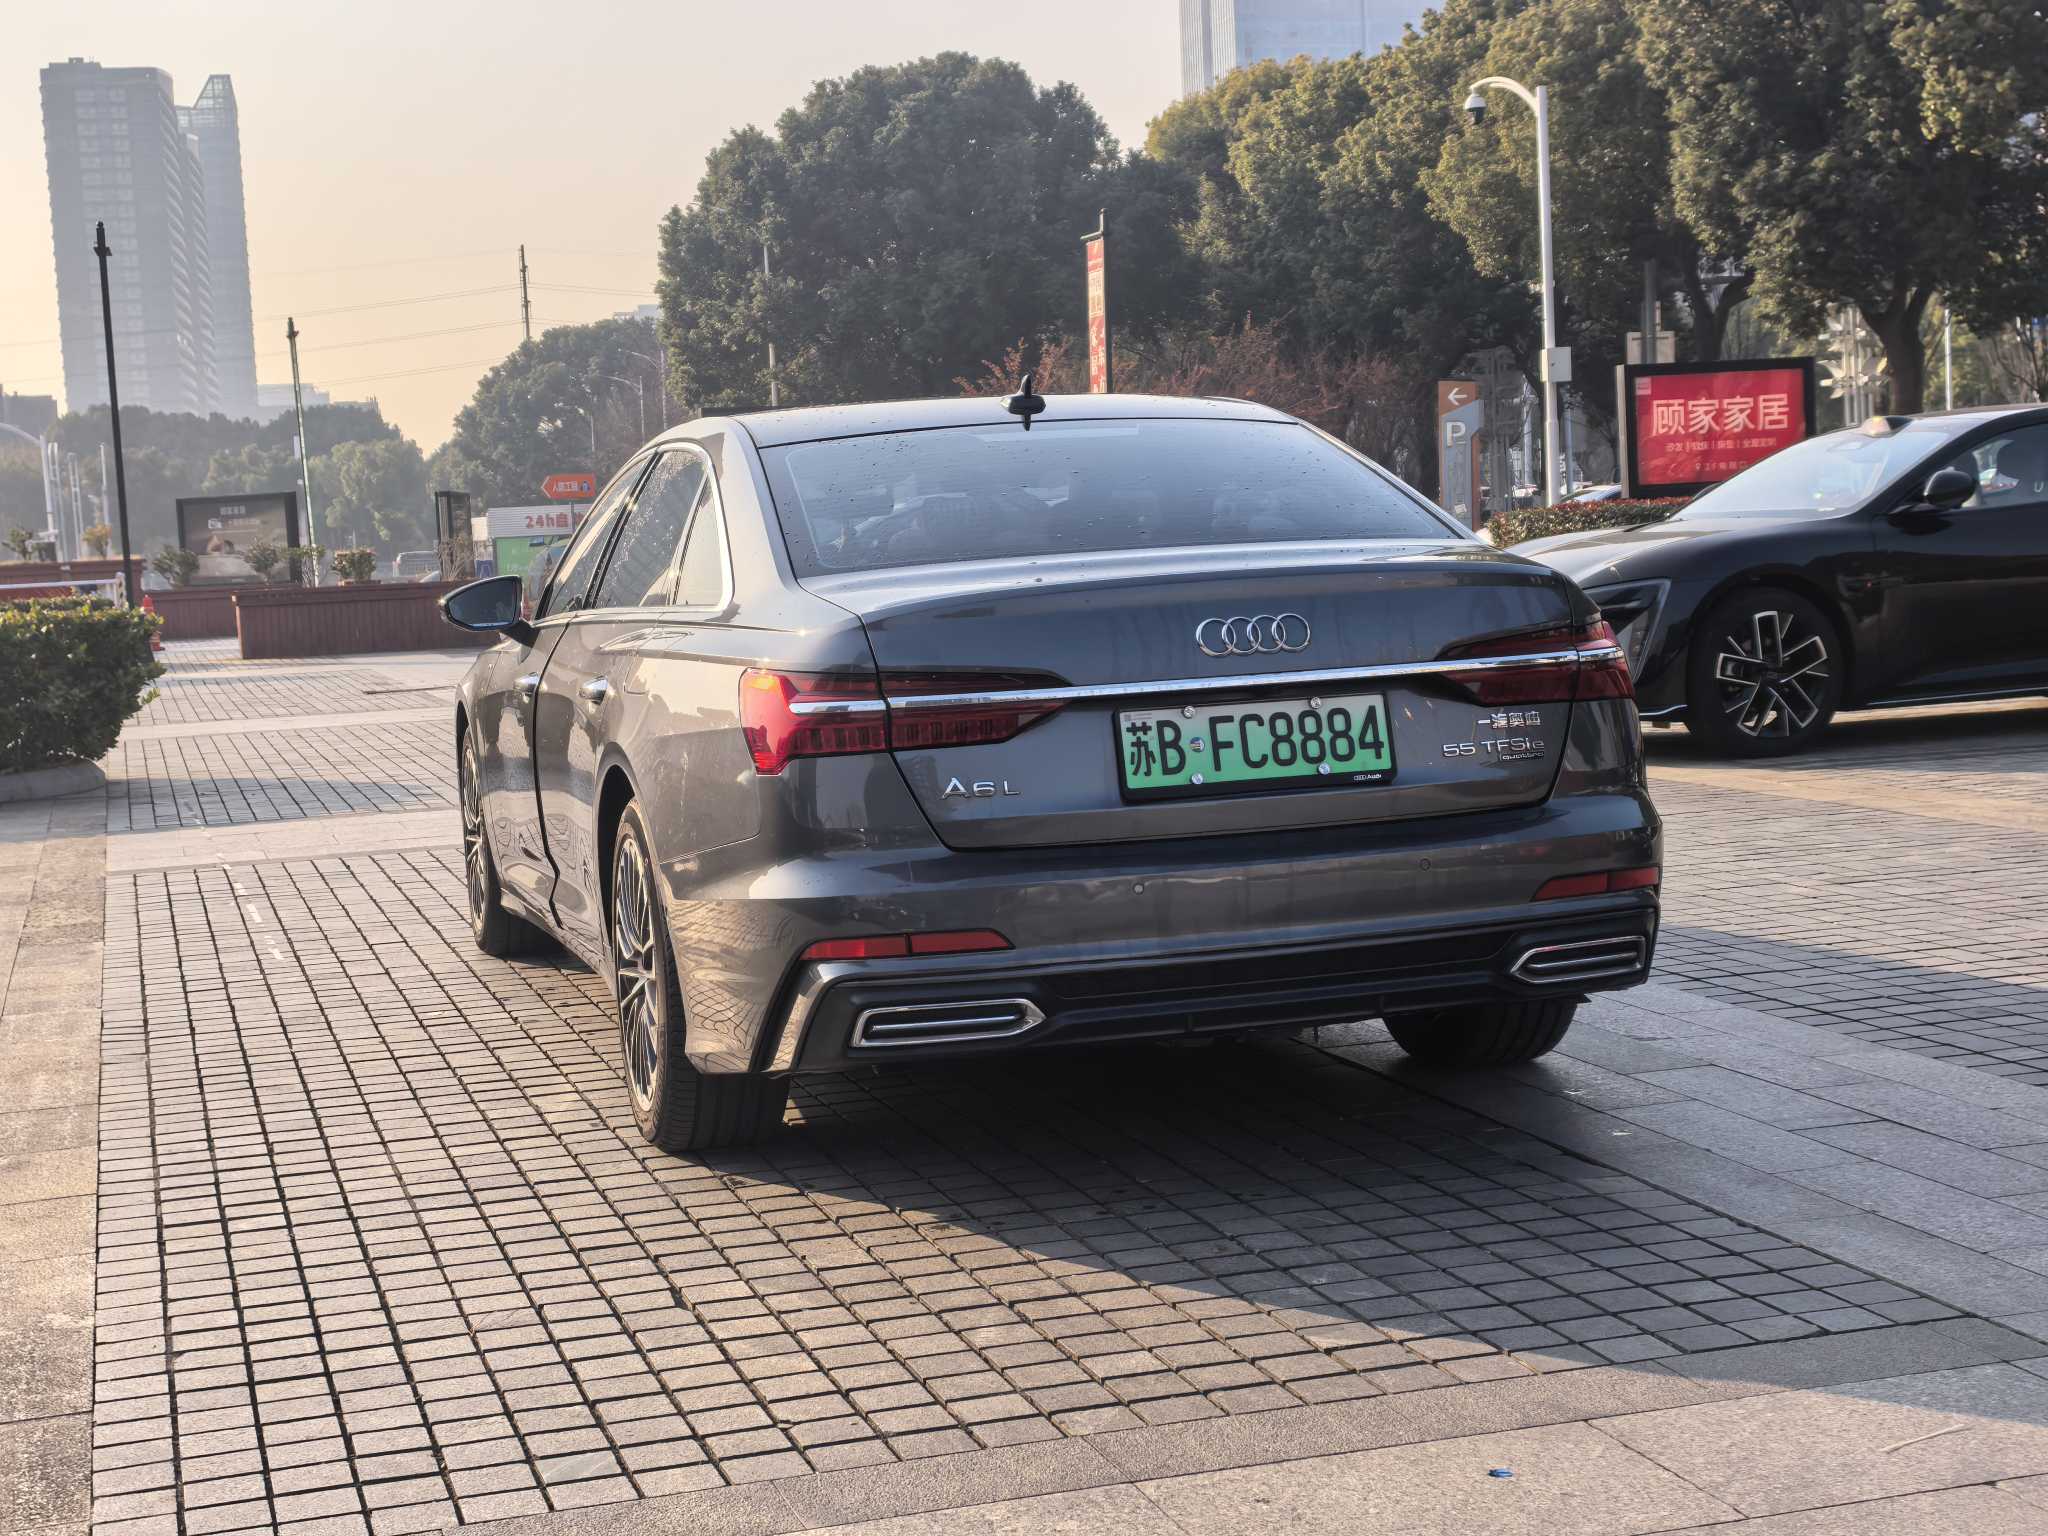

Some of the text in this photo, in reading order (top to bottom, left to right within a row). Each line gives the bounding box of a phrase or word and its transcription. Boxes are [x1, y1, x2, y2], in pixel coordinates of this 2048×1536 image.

[1652, 393, 1790, 436] 顾家家居
[1446, 421, 1466, 448] P
[1478, 711, 1541, 729] 一汽奥迪
[1443, 742, 1476, 757] 55
